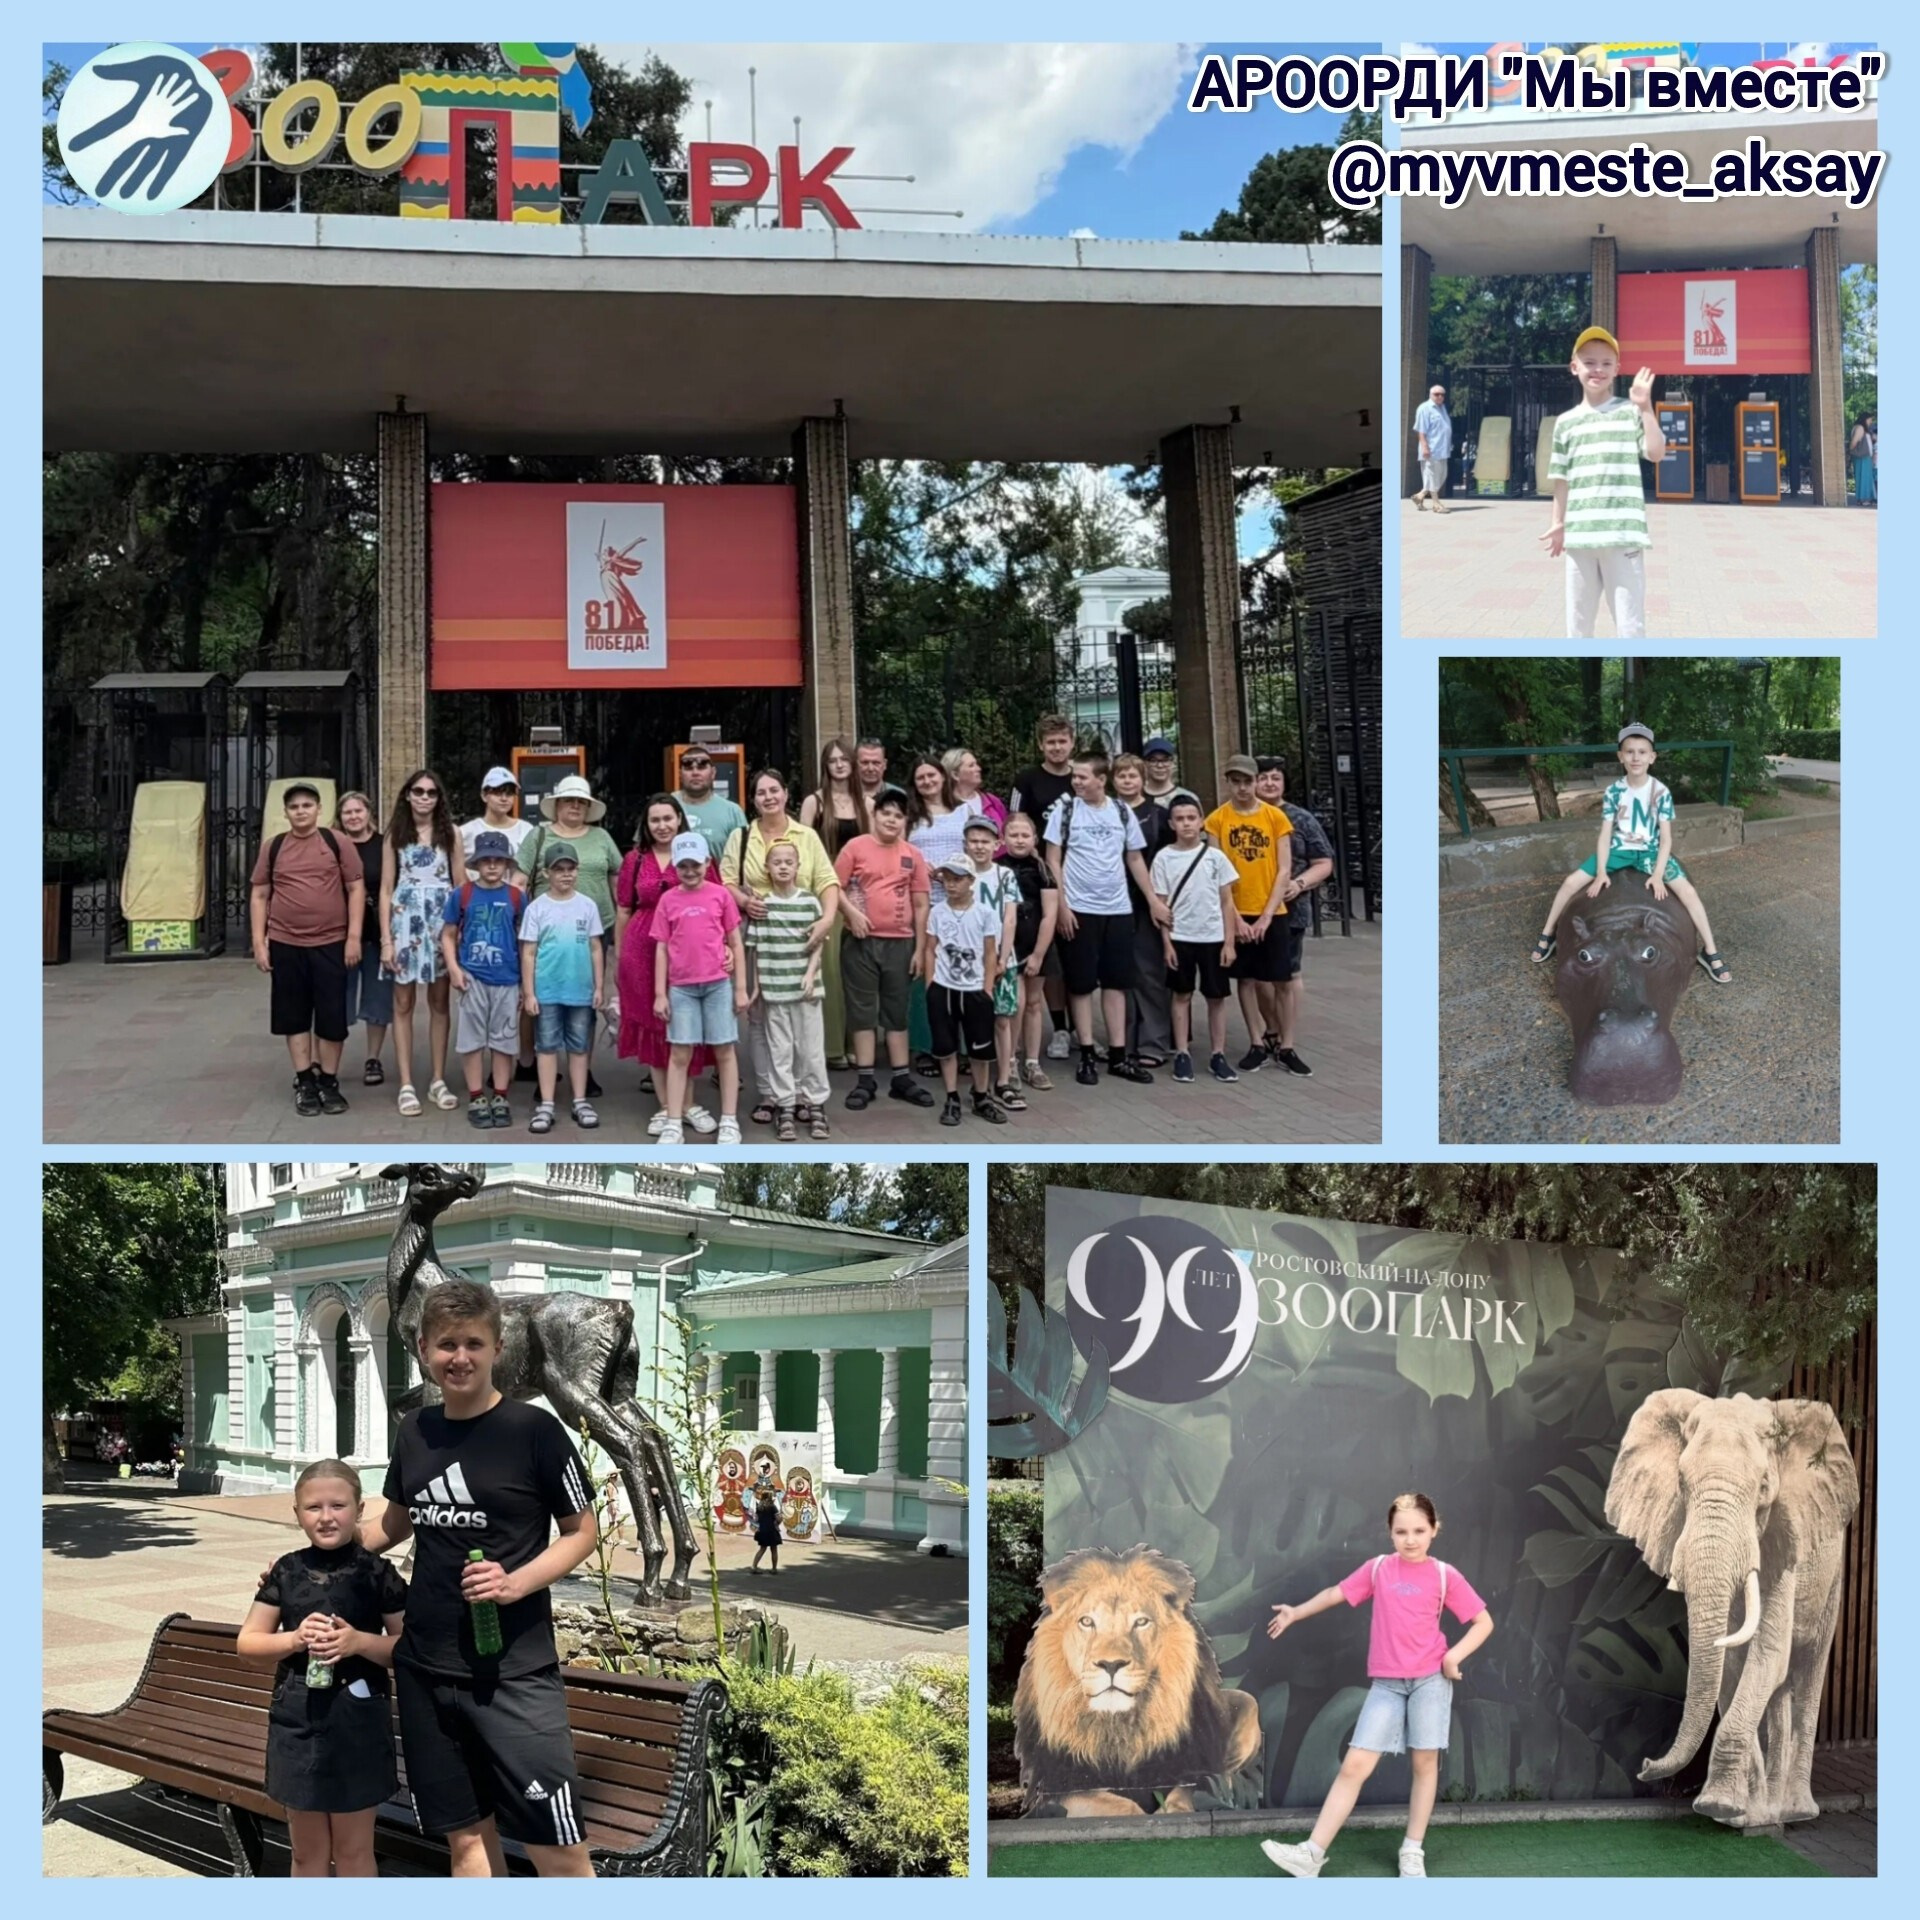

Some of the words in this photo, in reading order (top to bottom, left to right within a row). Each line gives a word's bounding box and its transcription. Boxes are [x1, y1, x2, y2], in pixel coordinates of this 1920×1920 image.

[1693, 330, 1709, 345] 81
[585, 600, 615, 630] 81
[585, 635, 650, 653] ПОБЕДА!
[1192, 1268, 1237, 1289] ЛЕТ
[1256, 1251, 1492, 1291] РОСТОВСКИЙ-НА-ДОНУ
[1067, 1232, 1259, 1383] 99
[1256, 1277, 1528, 1345] ЗООПАРК
[408, 1504, 488, 1529] adidas
